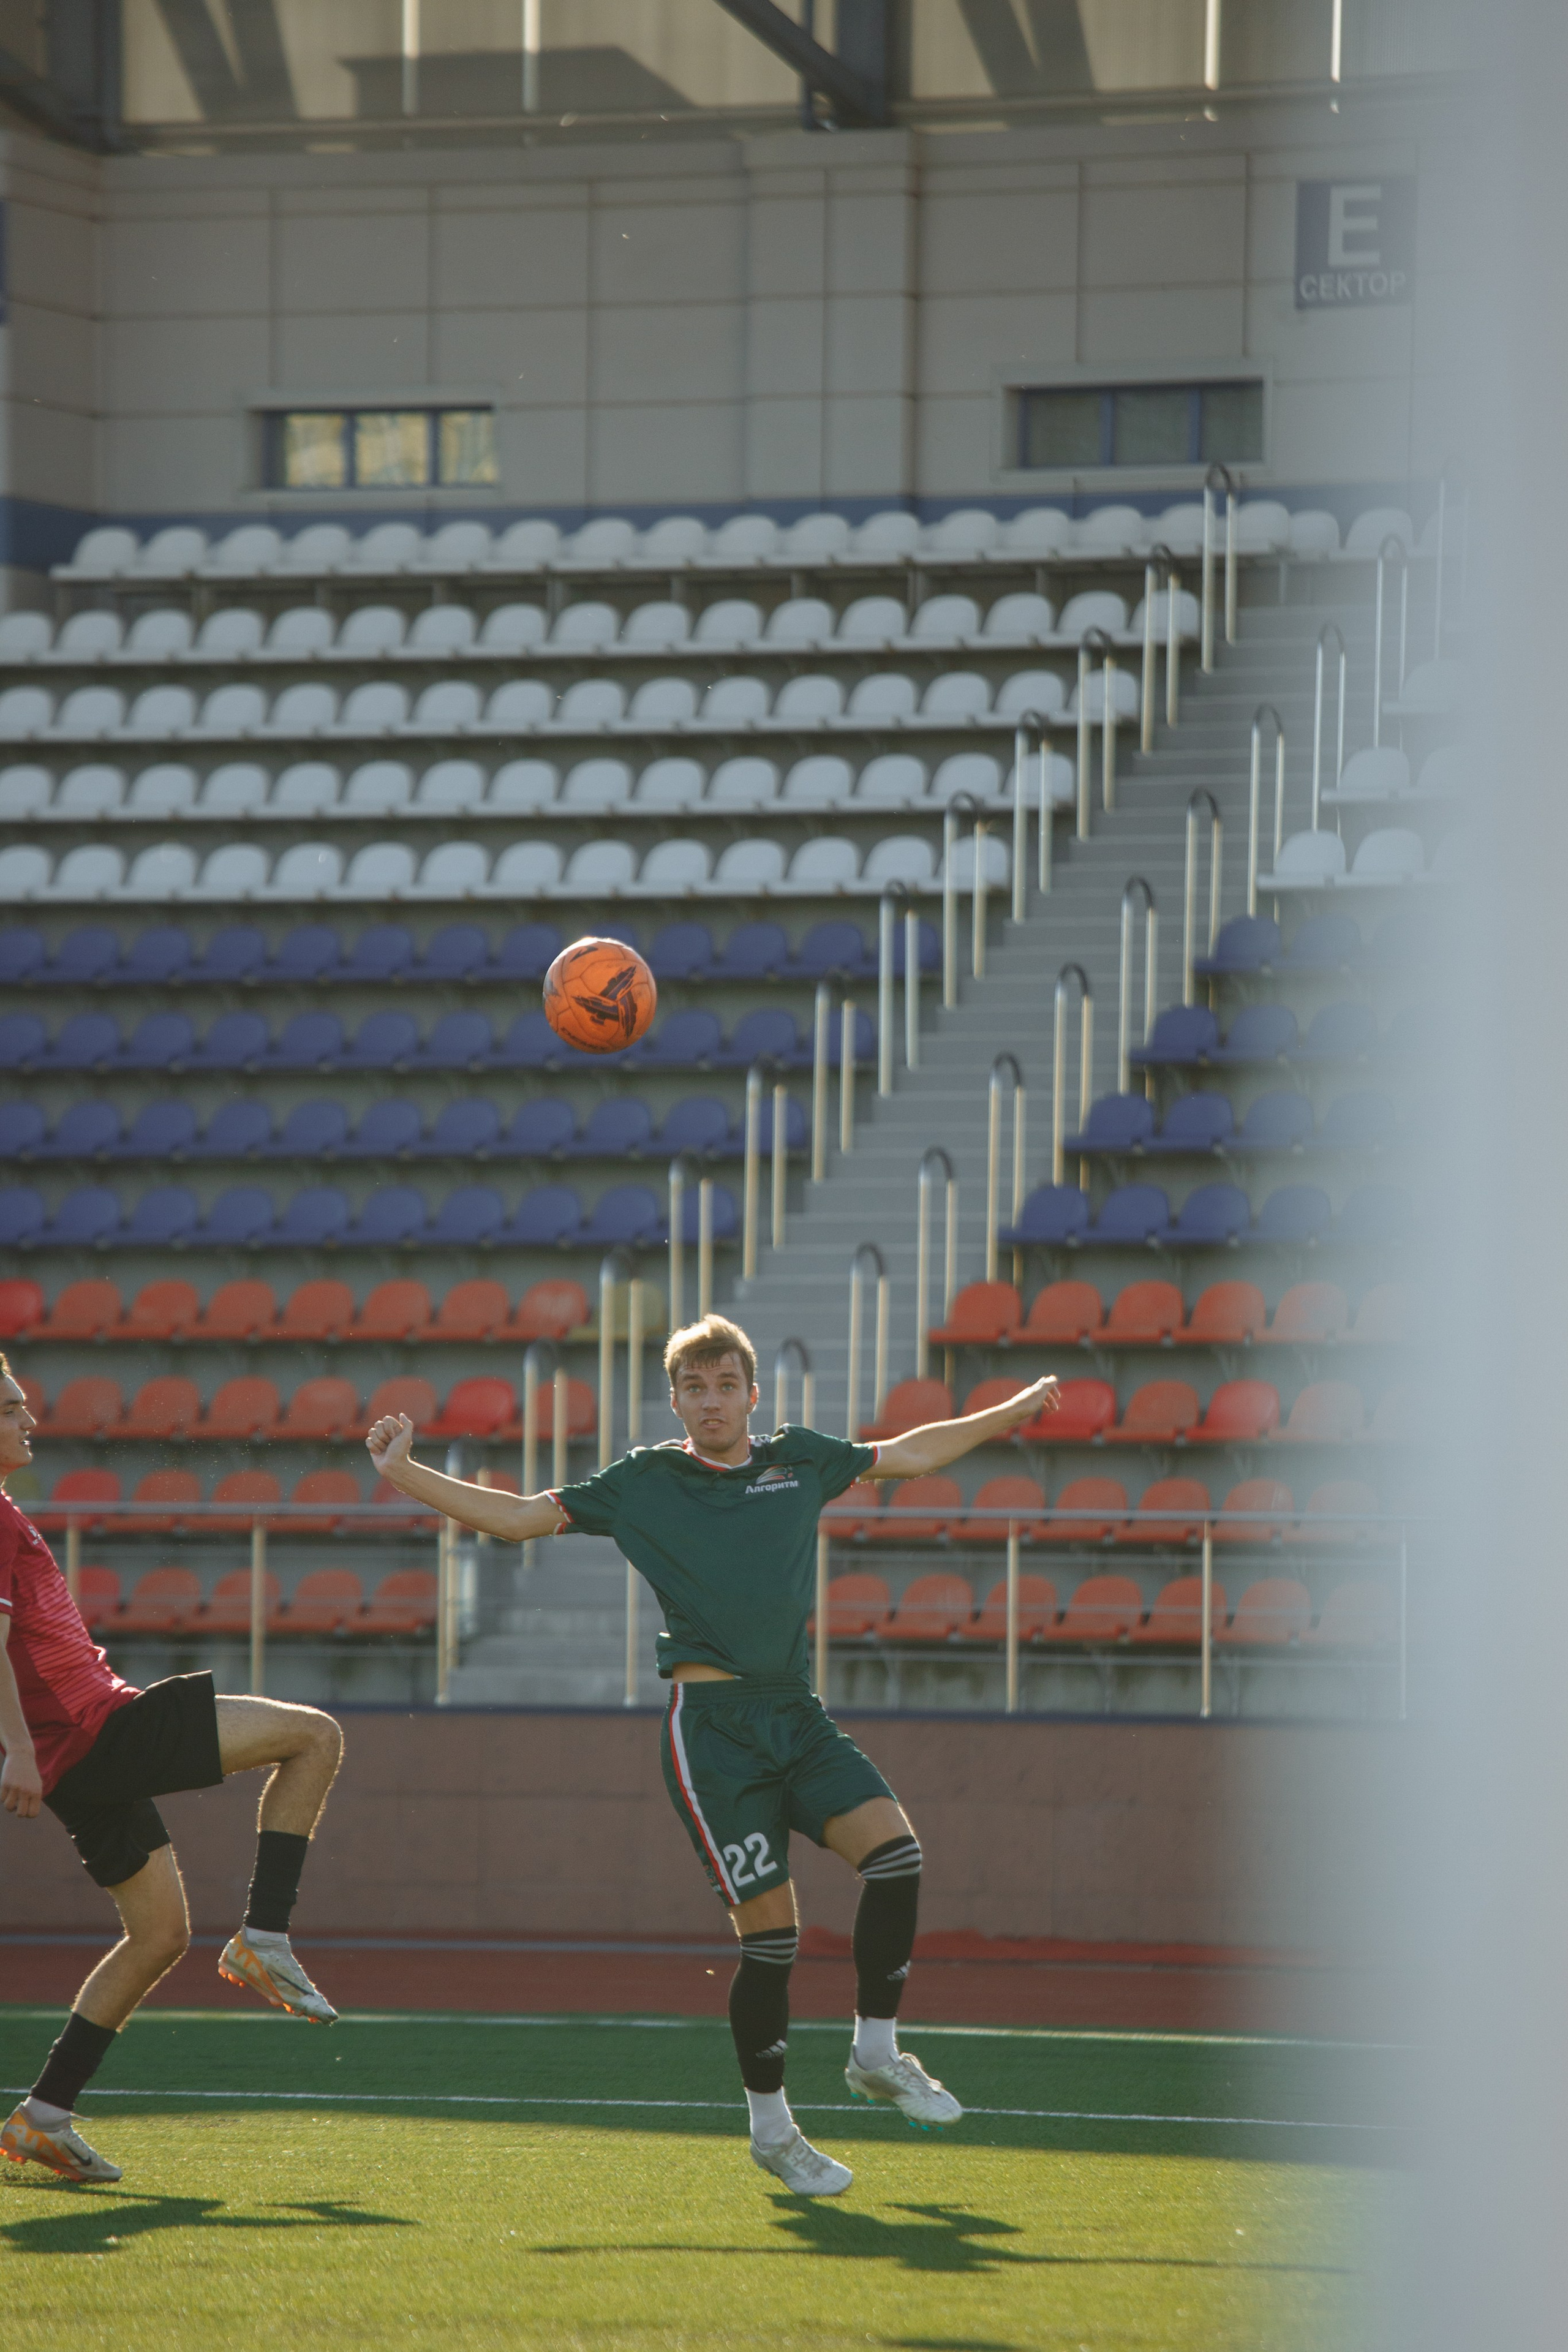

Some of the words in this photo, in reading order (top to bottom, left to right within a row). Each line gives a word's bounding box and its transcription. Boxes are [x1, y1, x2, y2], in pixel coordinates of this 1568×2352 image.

[1299, 271, 1406, 301] СЕКТОР
[745, 1480, 798, 1494] Алгоритм
[723, 1832, 777, 1887] 22
